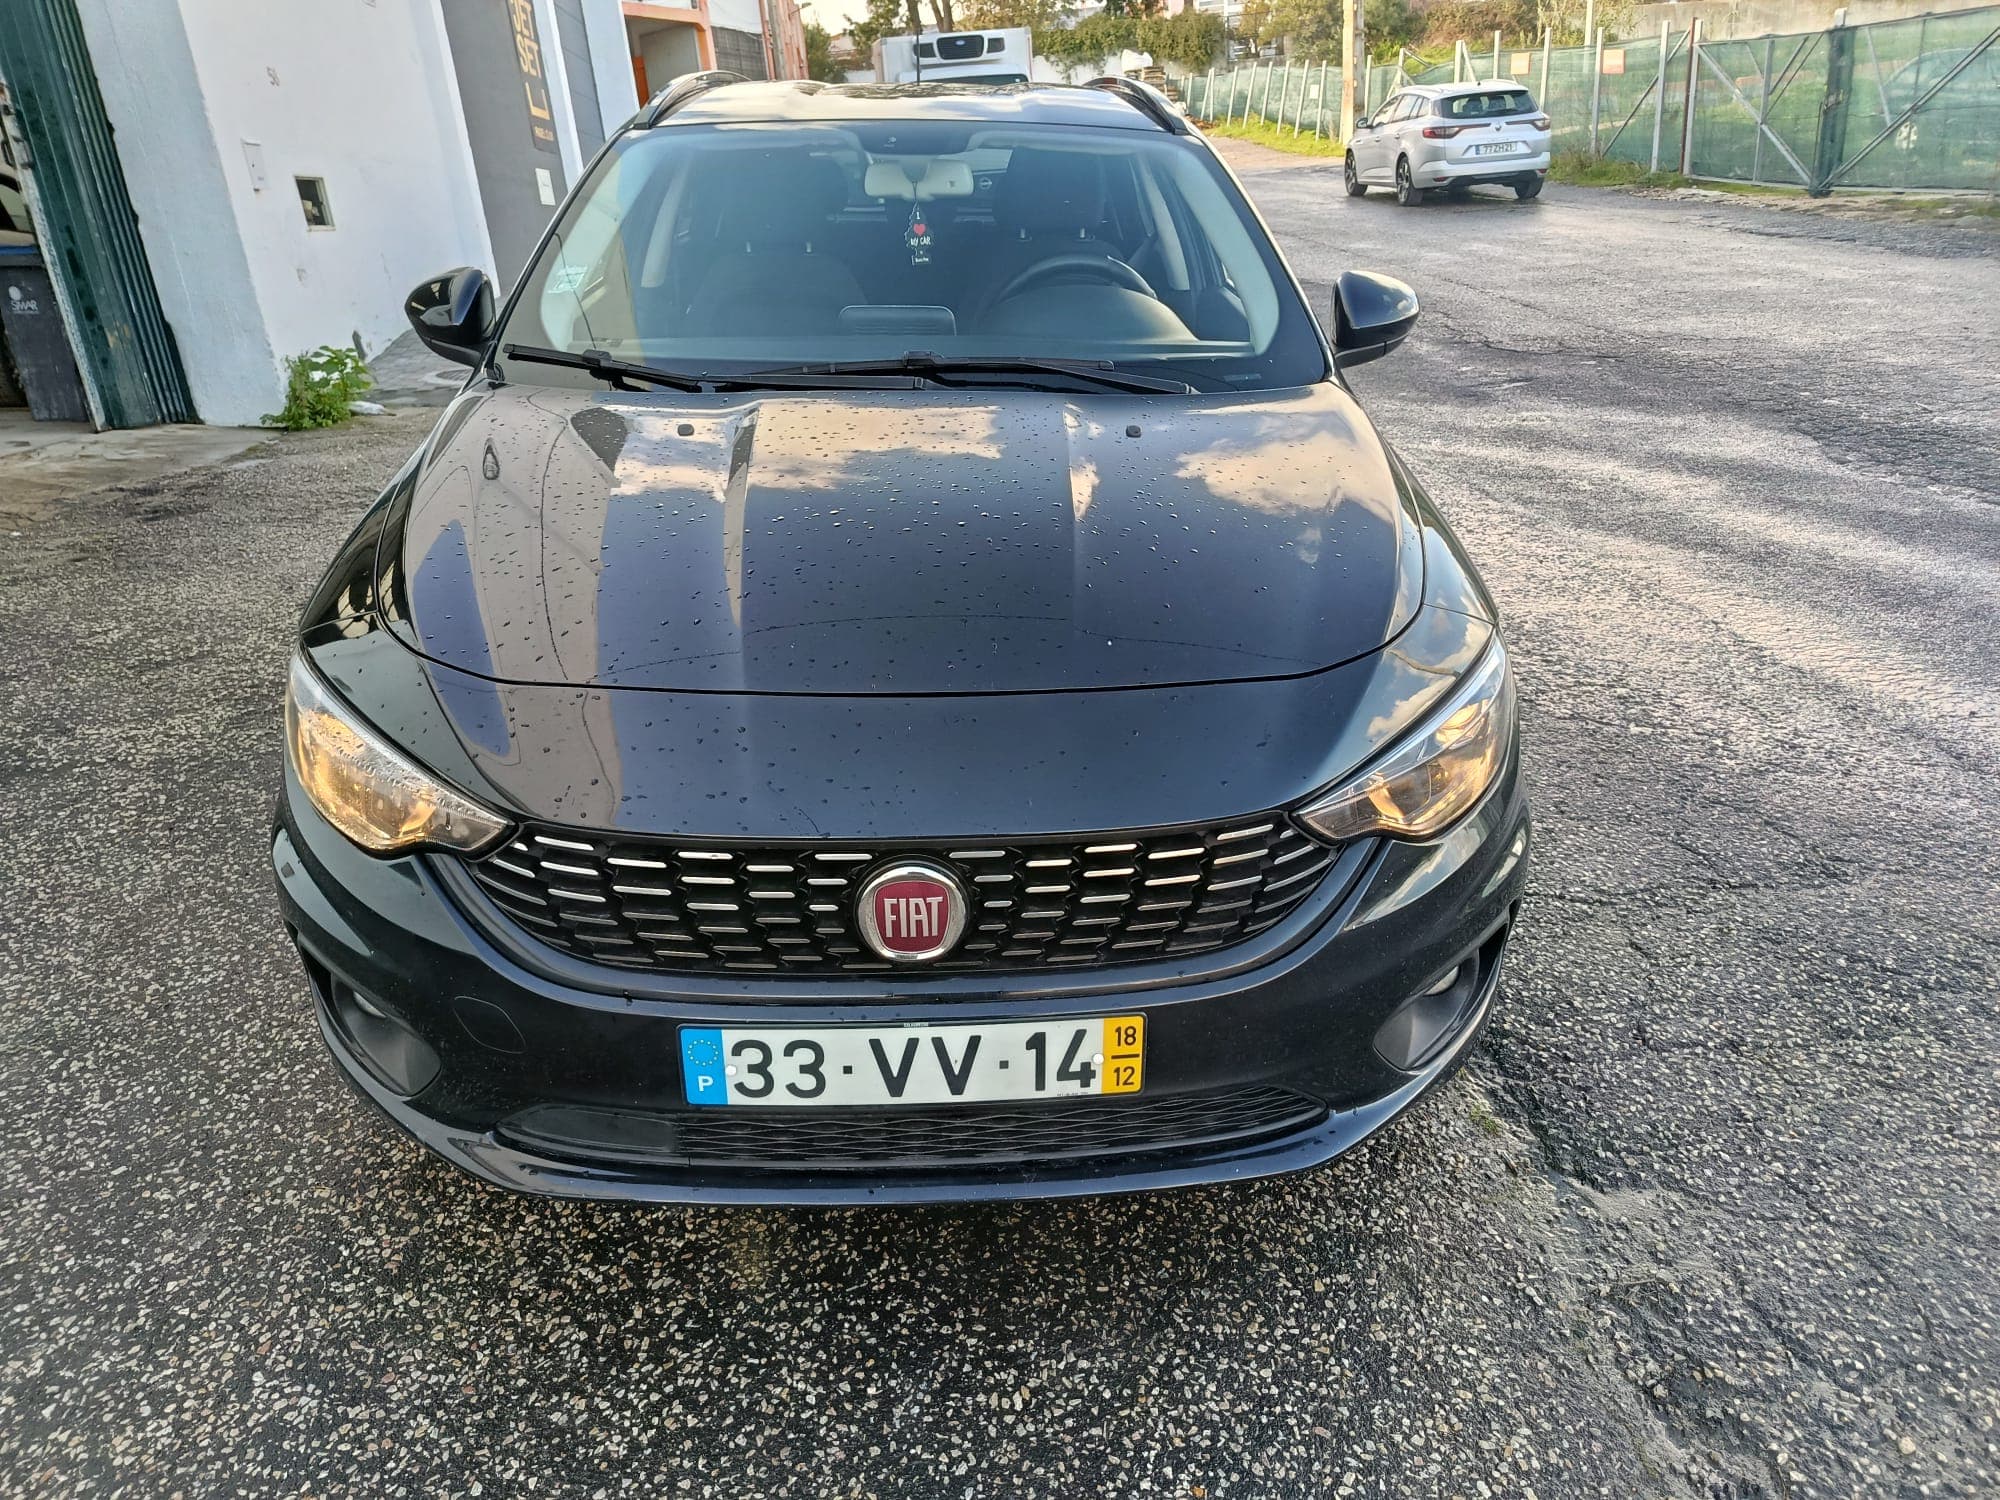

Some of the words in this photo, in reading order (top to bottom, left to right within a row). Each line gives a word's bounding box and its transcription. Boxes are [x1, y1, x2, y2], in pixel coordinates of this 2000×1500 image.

[516, 33, 542, 78] SET
[920, 235, 931, 246] CAR
[884, 896, 944, 938] FIAT
[1114, 1025, 1137, 1047] 18
[698, 1075, 714, 1092] P
[1112, 1065, 1136, 1087] 12
